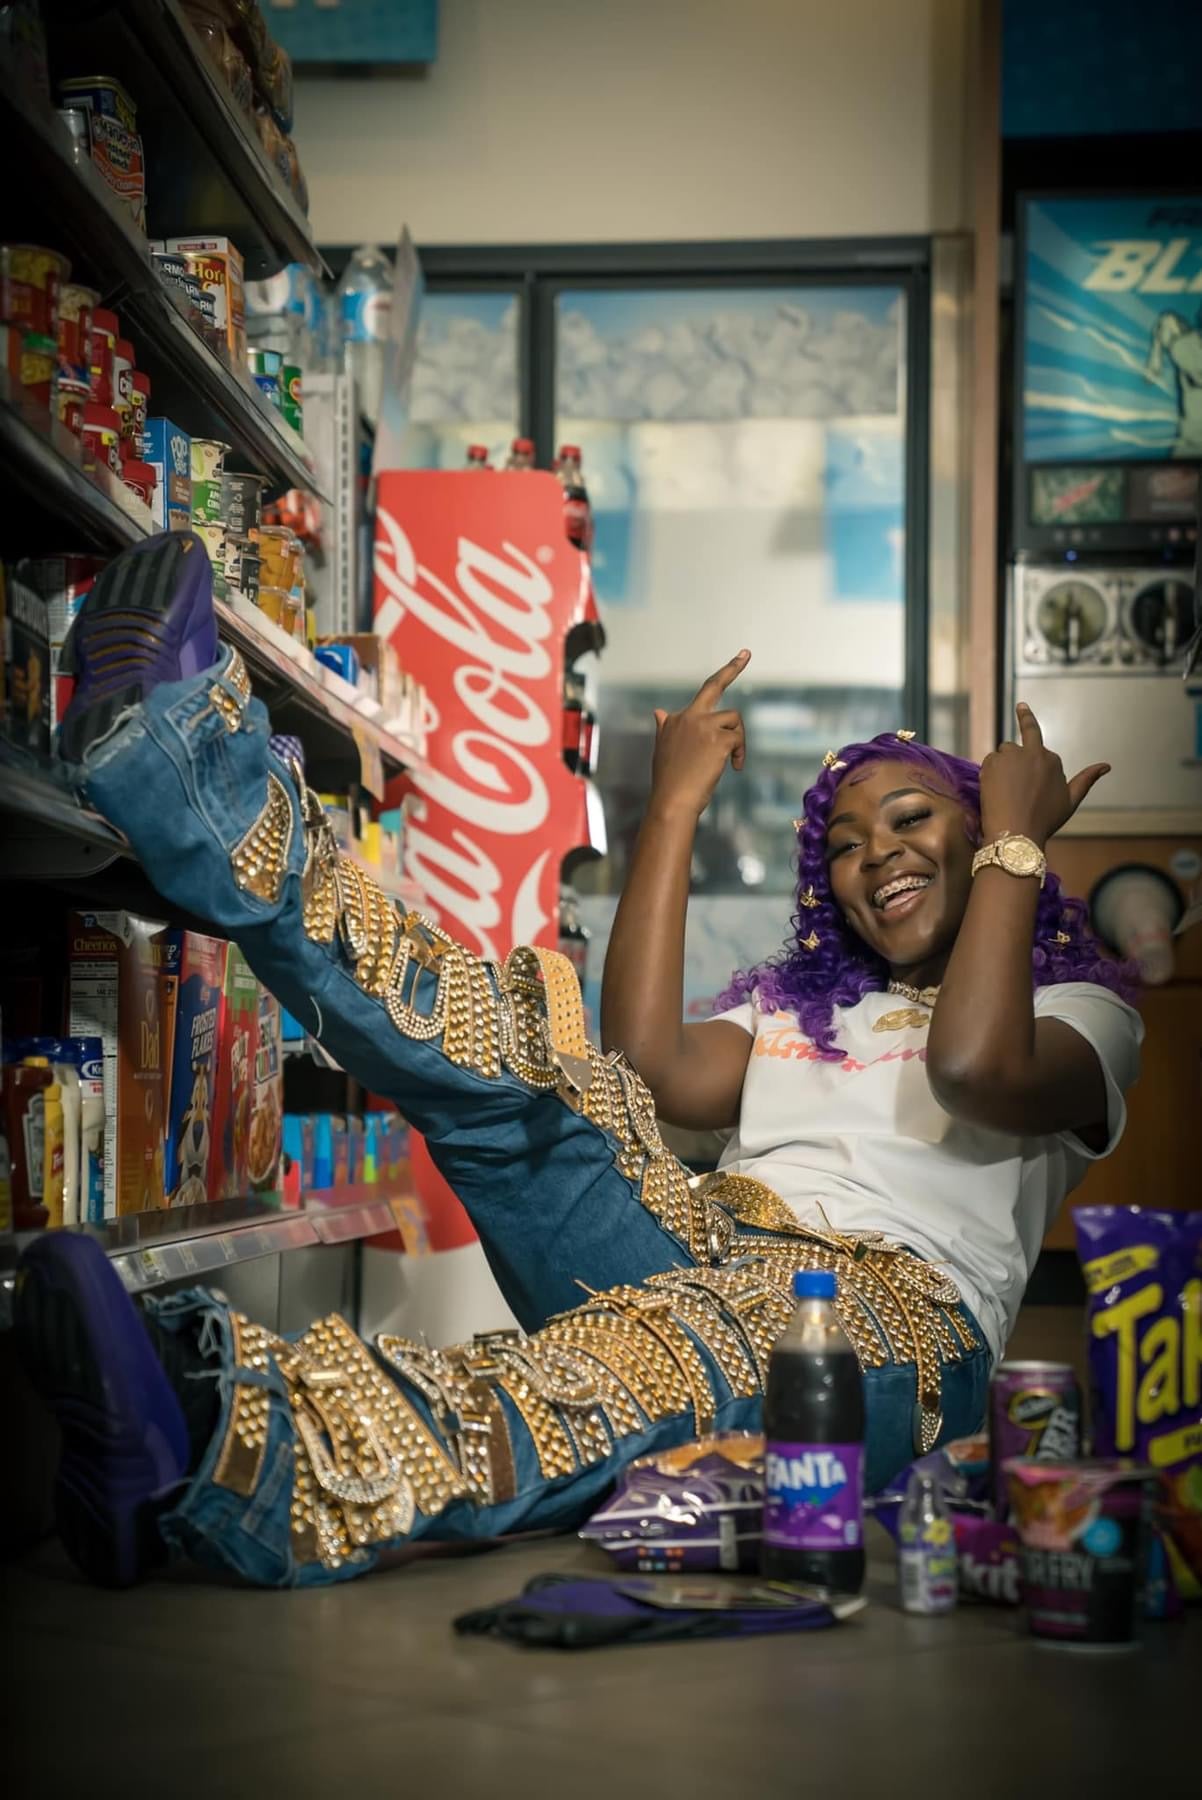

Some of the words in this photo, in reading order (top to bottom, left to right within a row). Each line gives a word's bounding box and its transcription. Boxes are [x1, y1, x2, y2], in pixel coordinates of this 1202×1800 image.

[1081, 237, 1202, 293] BL
[73, 936, 117, 953] Cheerios
[191, 1030, 214, 1061] FLAKES
[766, 1451, 847, 1492] FANTA
